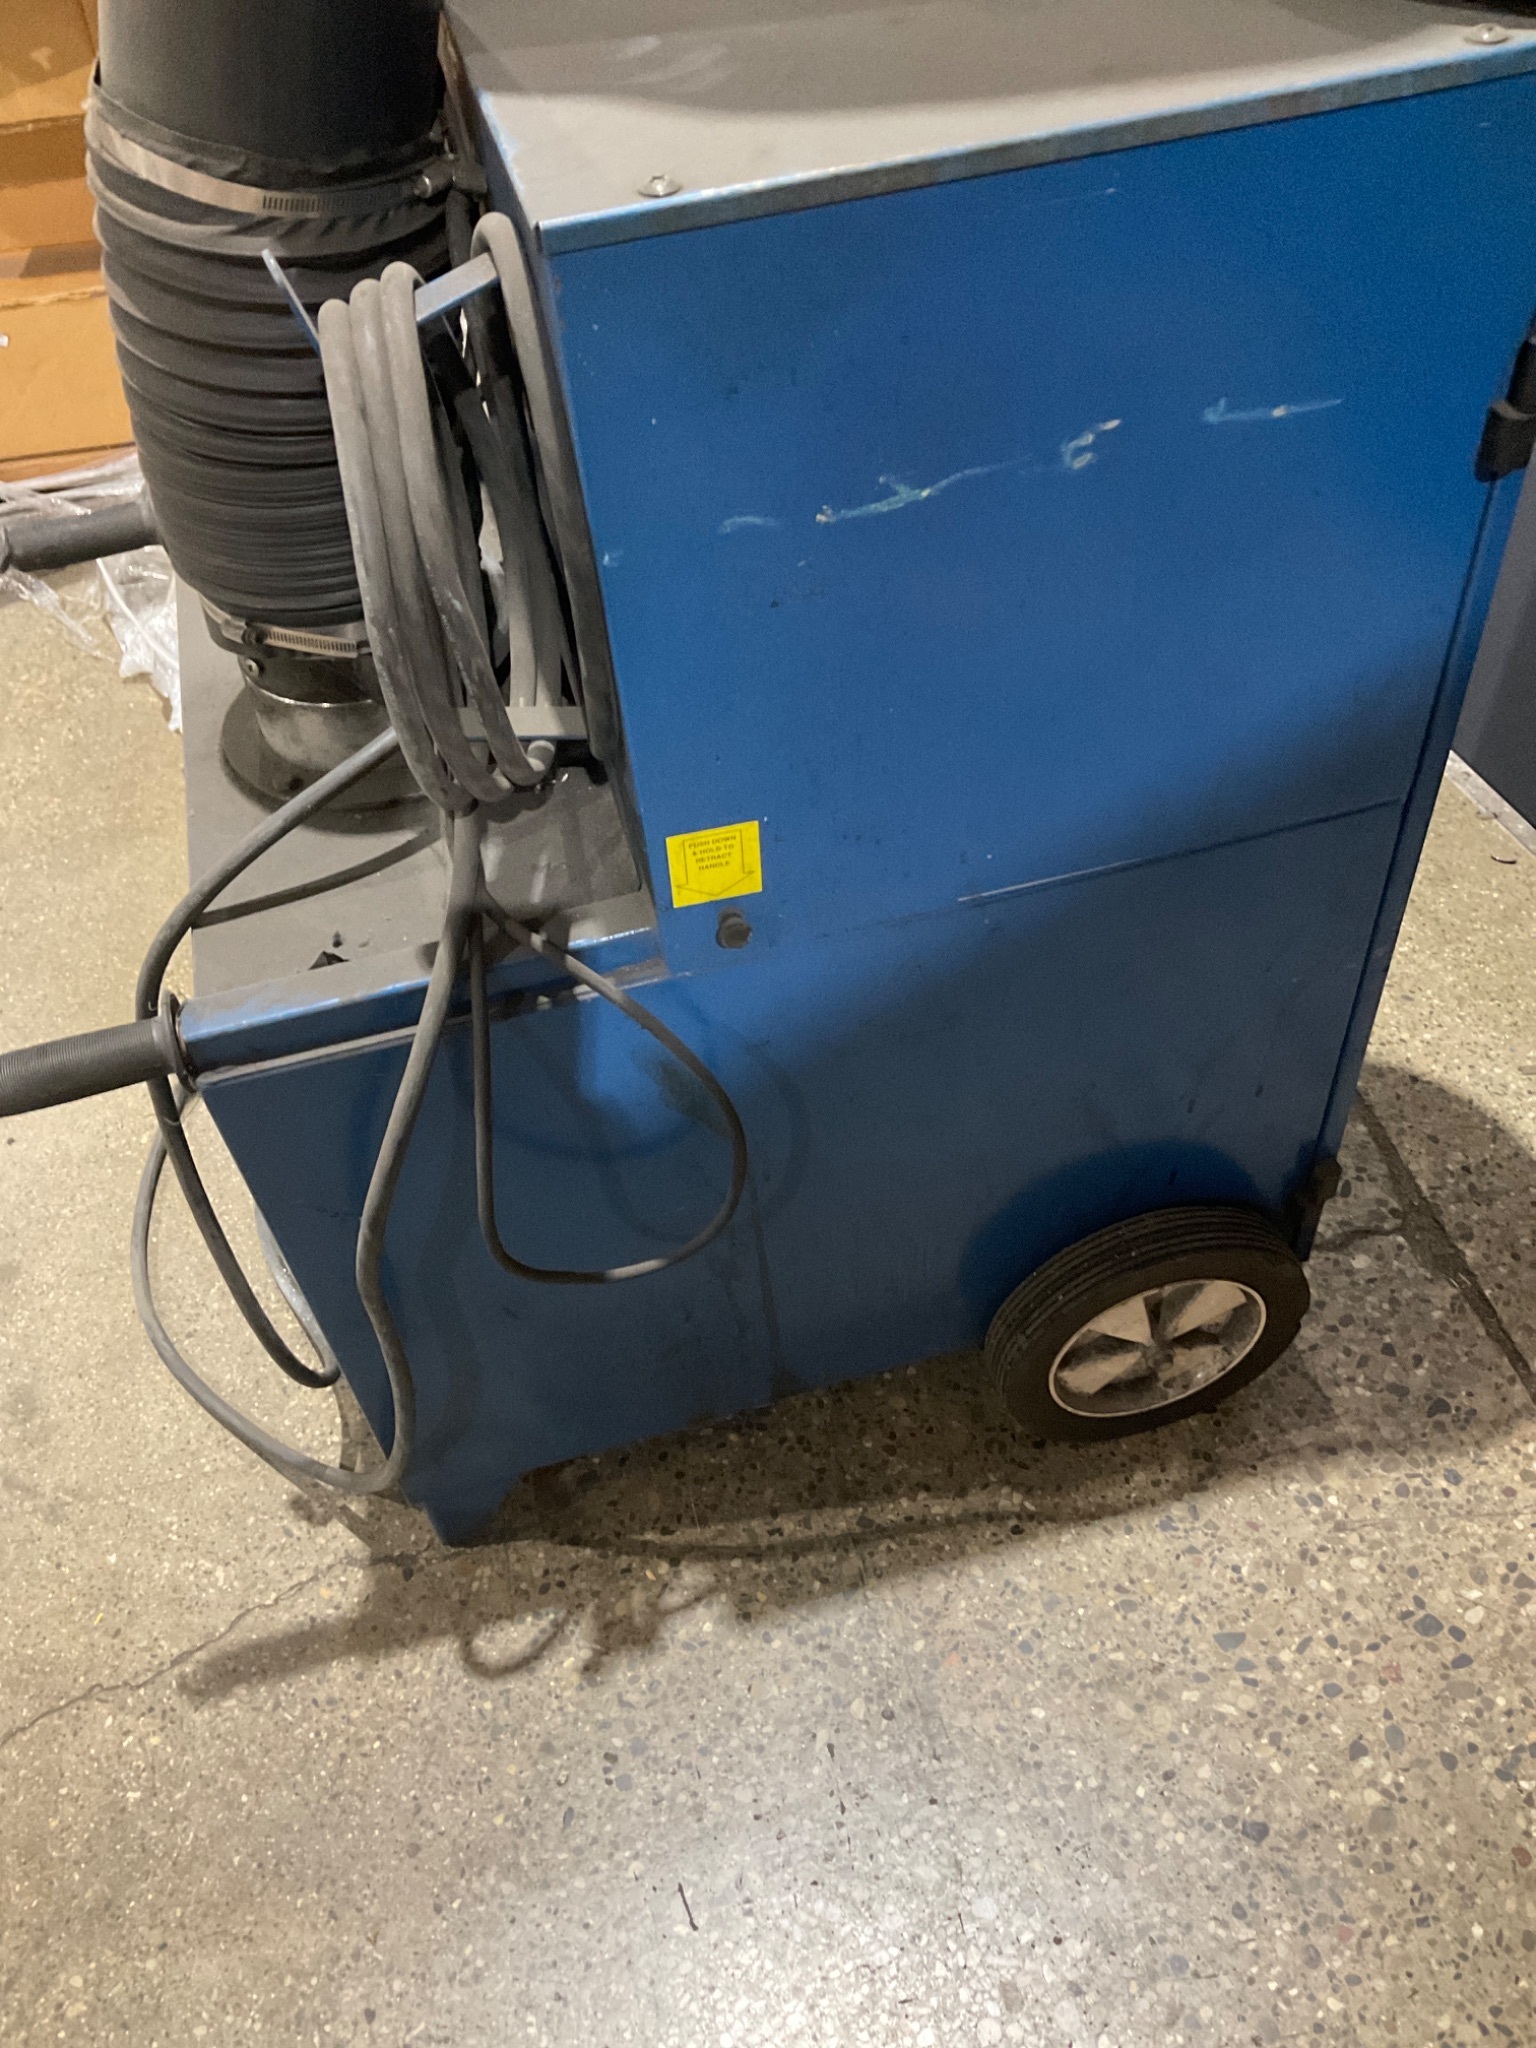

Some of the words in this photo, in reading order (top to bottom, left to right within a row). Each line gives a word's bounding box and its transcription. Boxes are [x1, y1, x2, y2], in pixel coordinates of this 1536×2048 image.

[688, 840, 709, 849] PUSH
[712, 835, 736, 844] DOWN
[700, 846, 721, 854] HOLD
[696, 852, 731, 864] RETRACT
[699, 860, 730, 870] HANDLE
